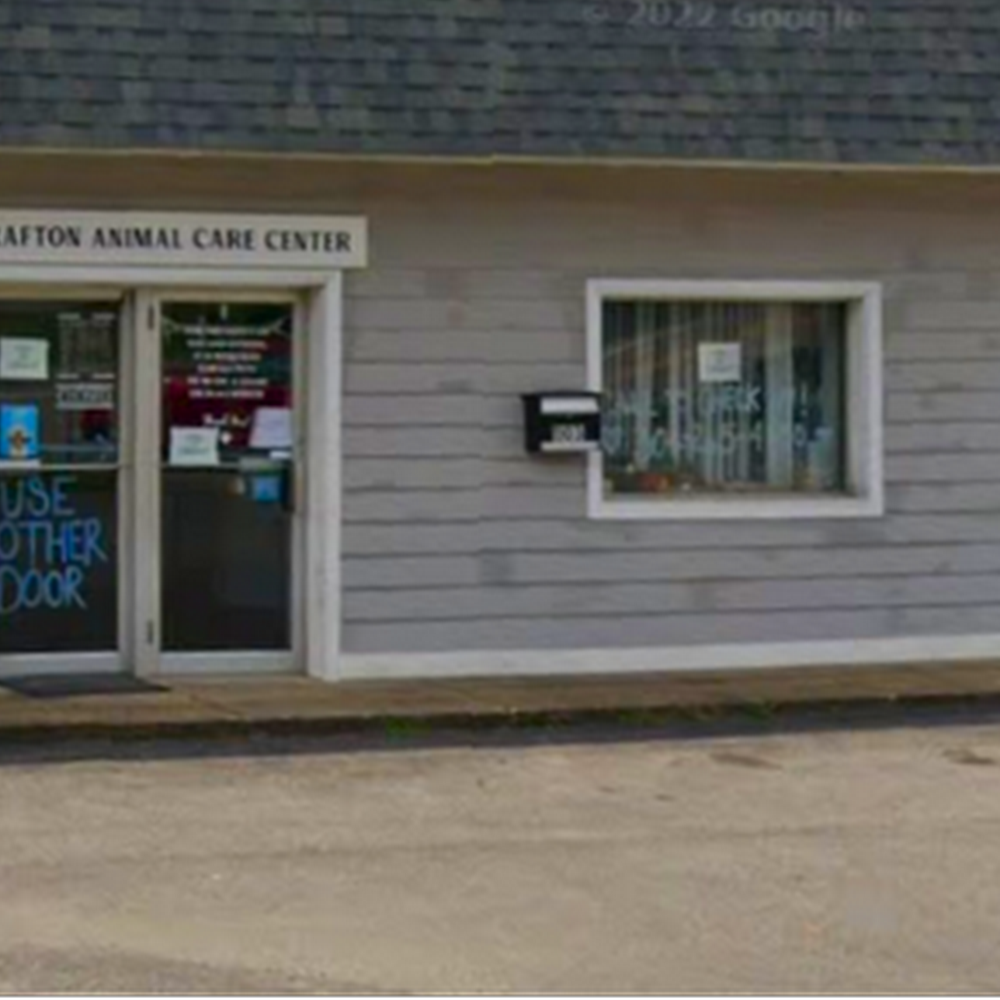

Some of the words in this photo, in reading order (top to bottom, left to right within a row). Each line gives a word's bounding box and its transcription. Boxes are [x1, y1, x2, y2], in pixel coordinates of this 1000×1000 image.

[92, 226, 184, 250] ANIMAL
[192, 226, 255, 251] CARE
[264, 228, 353, 253] CENTER
[0, 476, 78, 519] USE
